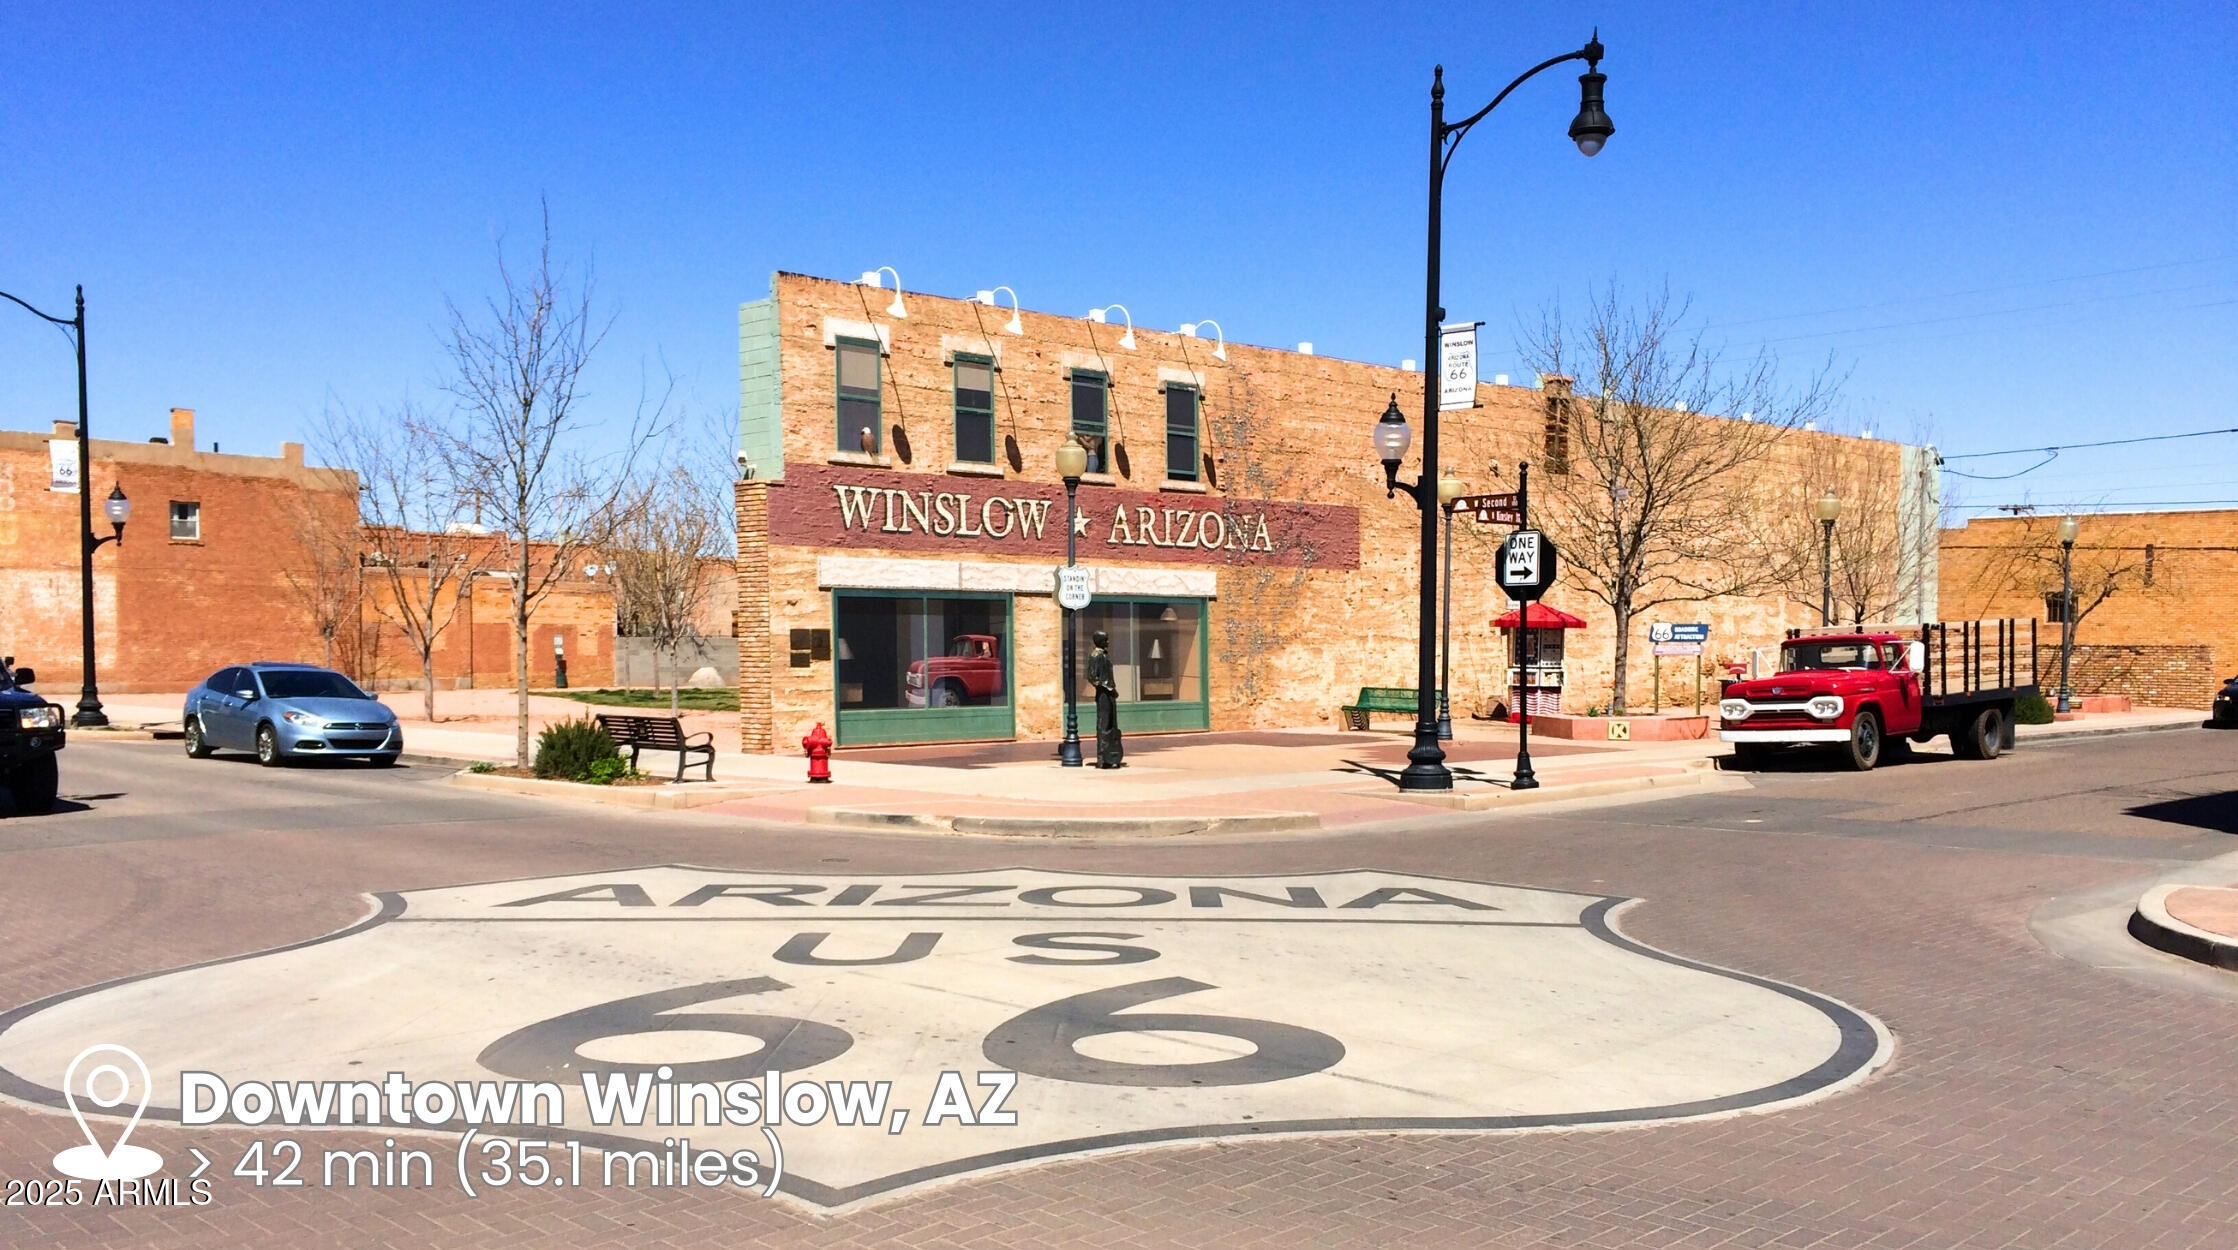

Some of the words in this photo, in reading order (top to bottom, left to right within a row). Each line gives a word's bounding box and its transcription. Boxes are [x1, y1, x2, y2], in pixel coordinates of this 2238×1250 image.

[1444, 340, 1473, 348] WINSLOW
[1450, 368, 1467, 380] 66
[59, 466, 73, 476] 66
[1482, 497, 1507, 508] Second
[833, 484, 1052, 540] WINSLOW
[1106, 503, 1273, 551] ARIZONA
[1509, 536, 1535, 550] ONE
[1509, 551, 1535, 564] WAY
[1655, 628, 1670, 640] 66
[488, 883, 1505, 911] ARIZONA
